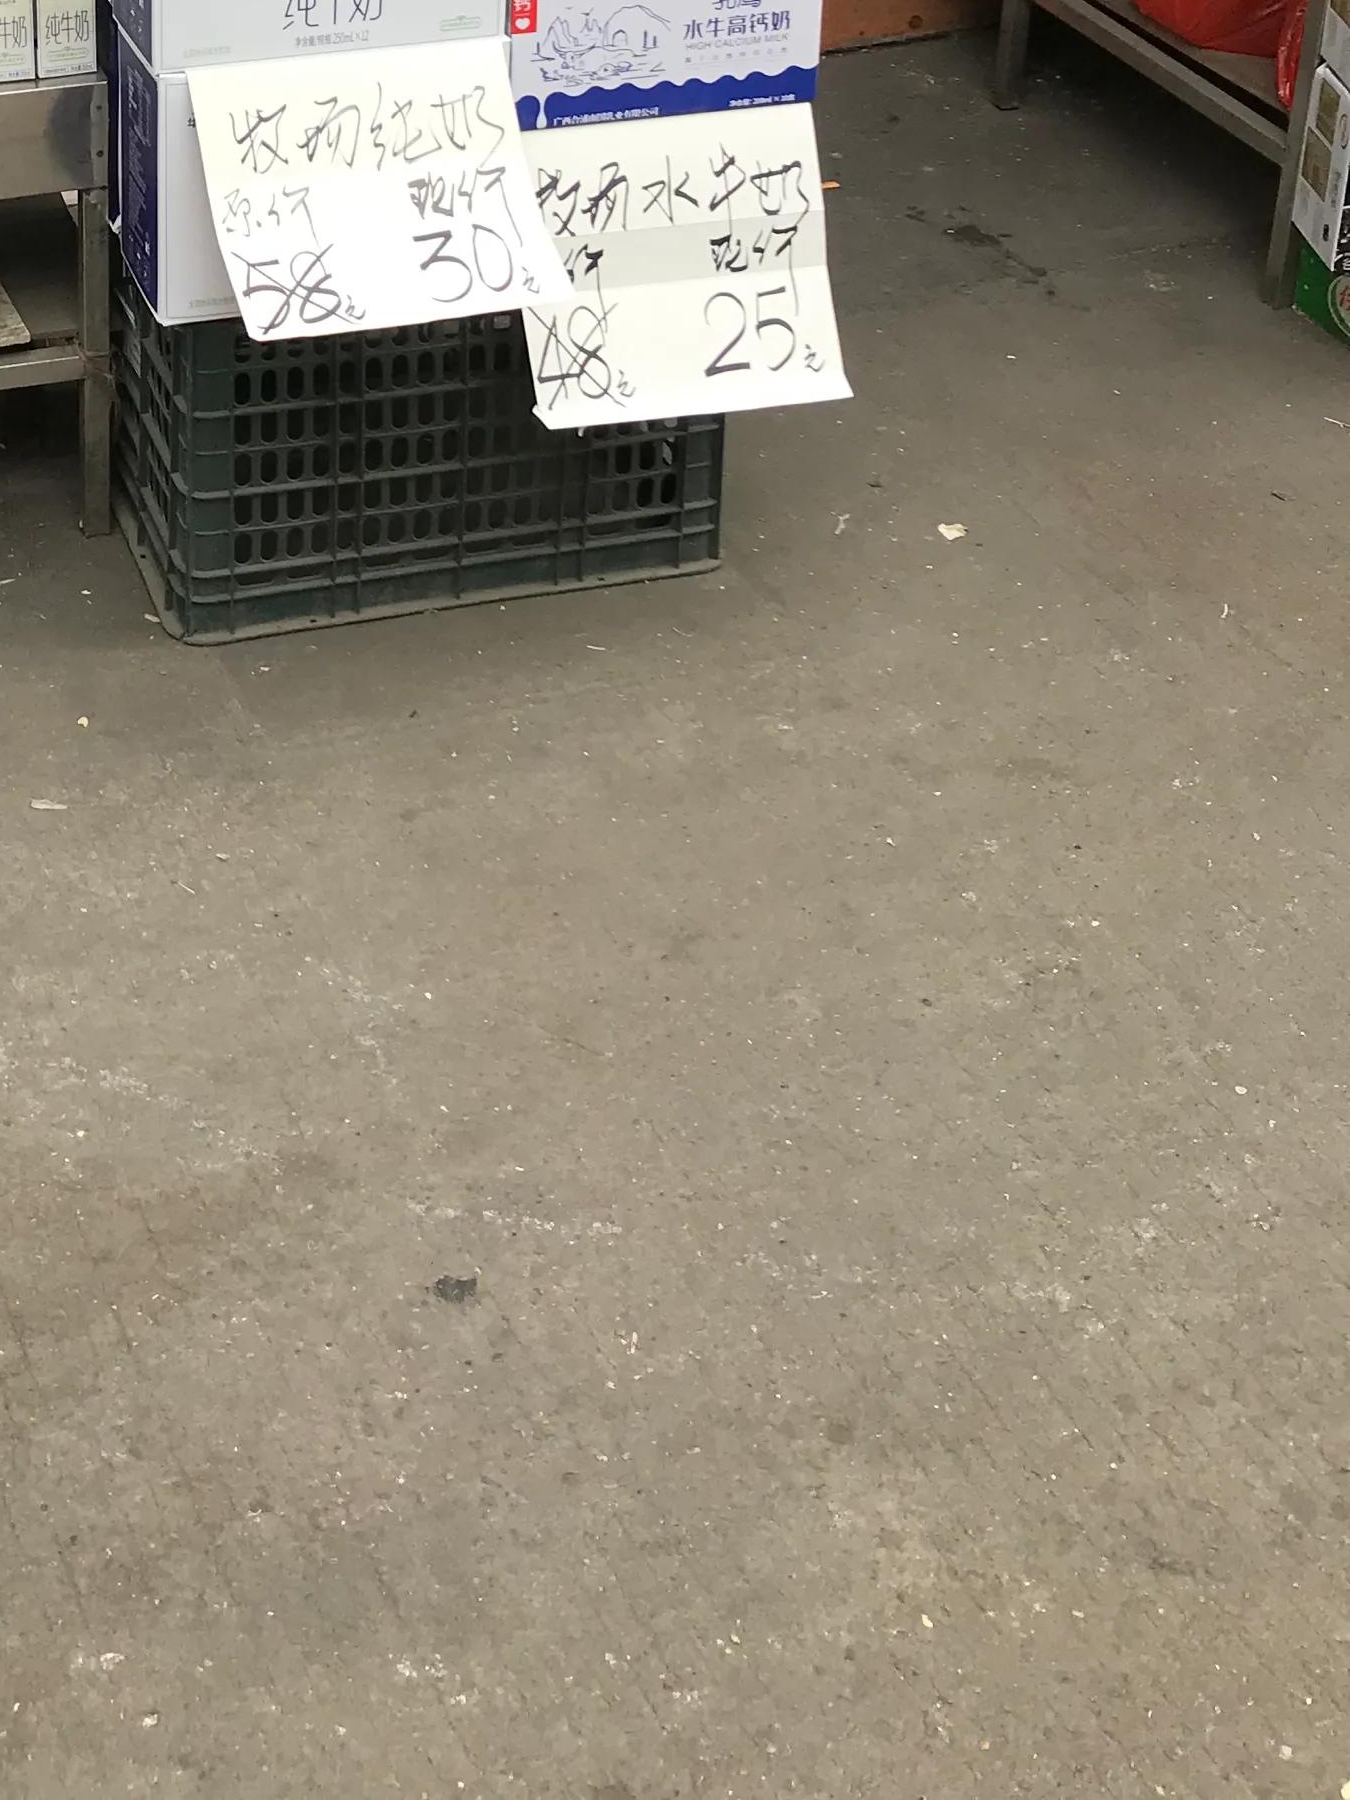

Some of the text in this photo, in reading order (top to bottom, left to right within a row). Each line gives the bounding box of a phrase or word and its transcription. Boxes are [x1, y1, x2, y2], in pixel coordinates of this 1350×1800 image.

[45, 10, 90, 46] 纯牛奶
[683, 10, 791, 41] 水牛高钙奶
[685, 33, 789, 52] HIGH CALCIUM MILK
